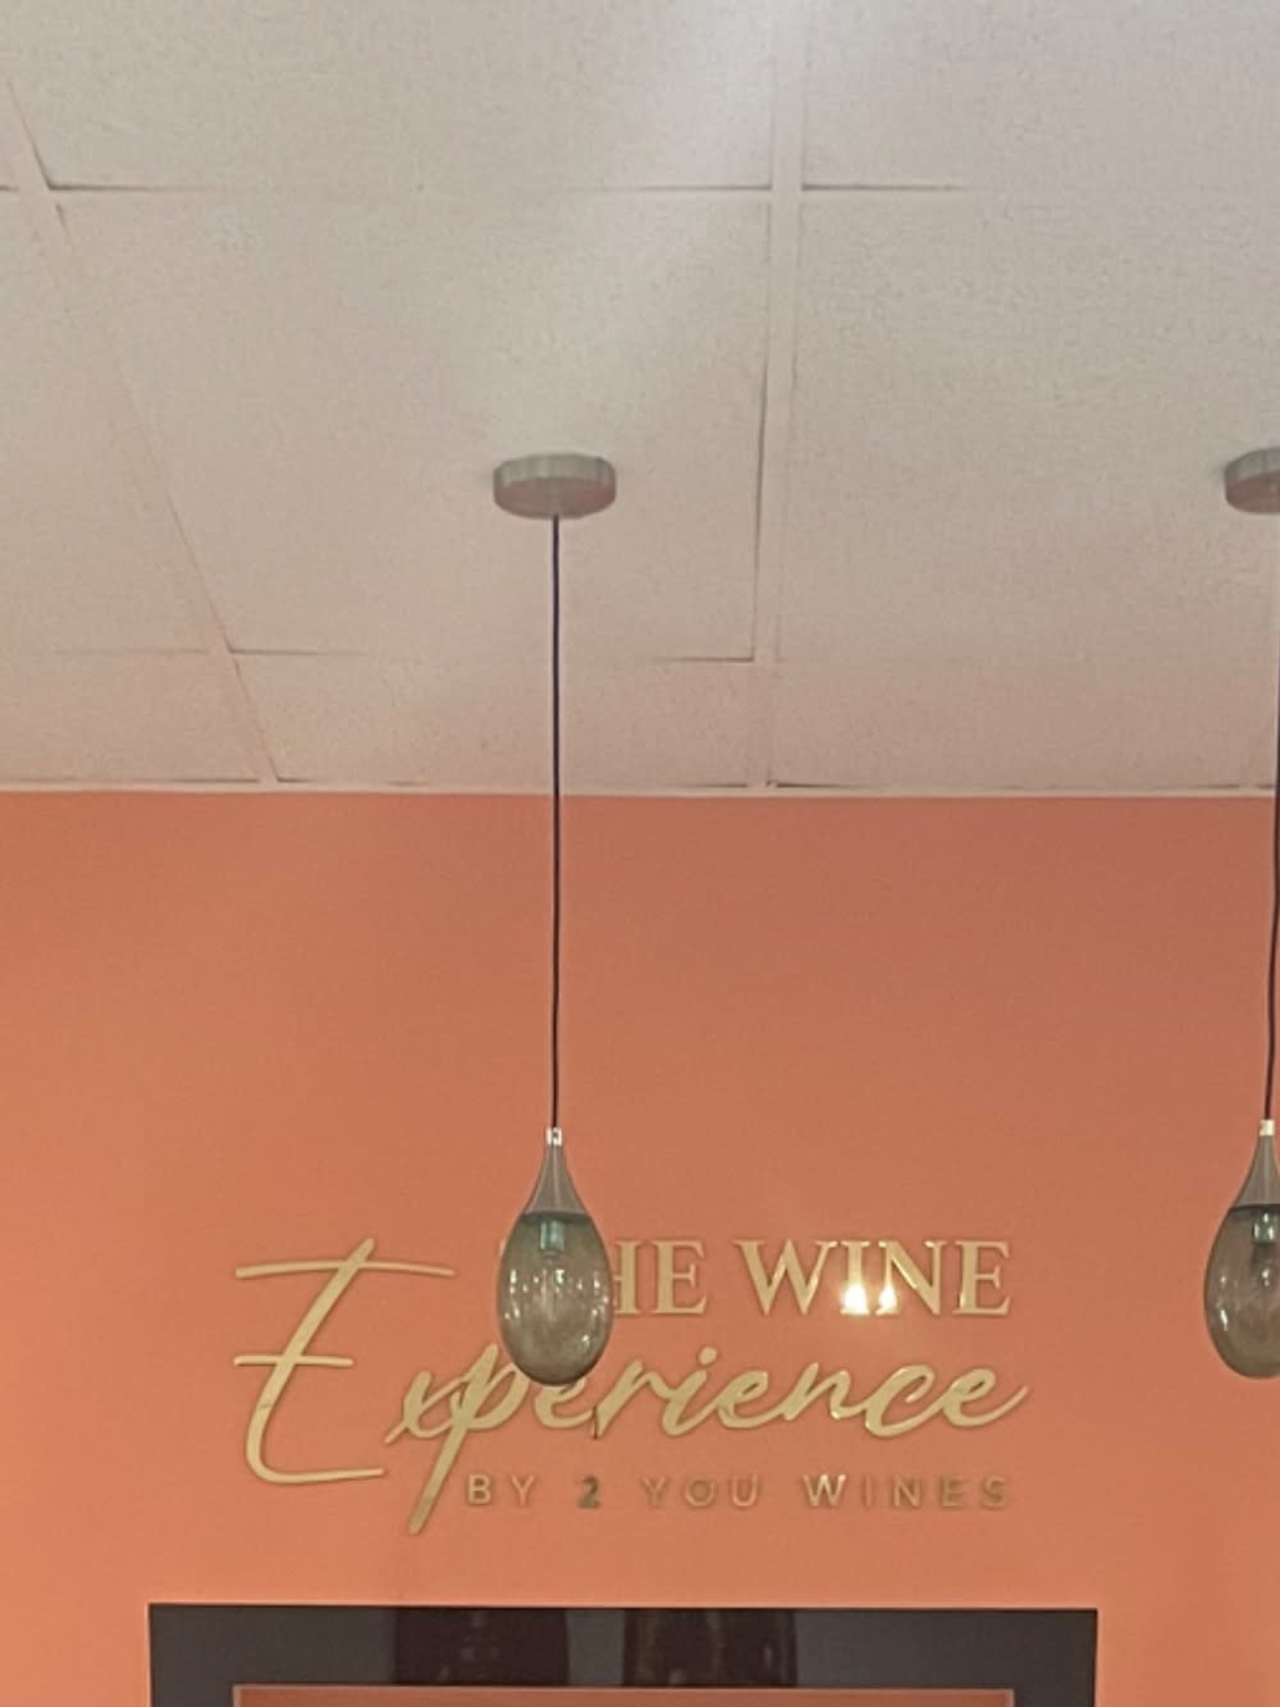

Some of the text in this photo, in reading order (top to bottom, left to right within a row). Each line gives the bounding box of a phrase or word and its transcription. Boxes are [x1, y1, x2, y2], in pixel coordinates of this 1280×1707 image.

[733, 1238, 1012, 1317] WINE
[233, 1236, 1029, 1536] Experience
[466, 1472, 1011, 1510] BY 2 YOU WINES
